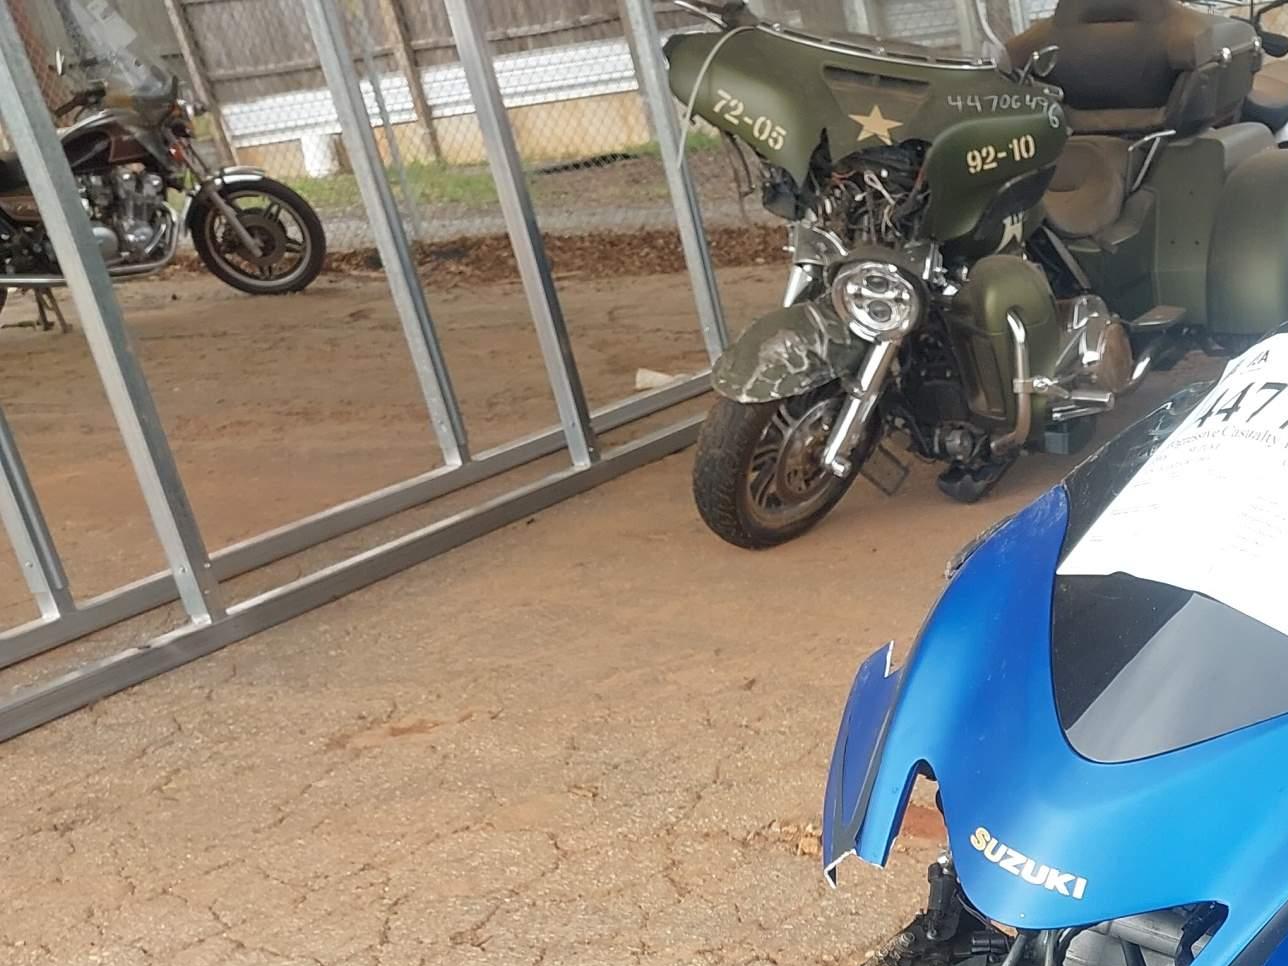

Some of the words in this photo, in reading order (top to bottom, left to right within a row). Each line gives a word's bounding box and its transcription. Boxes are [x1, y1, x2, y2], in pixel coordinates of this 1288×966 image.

[713, 89, 787, 150] 72-05
[966, 134, 1036, 174] 92-10
[1221, 425, 1278, 448] Casualty
[969, 826, 1088, 900] SUZUKI
